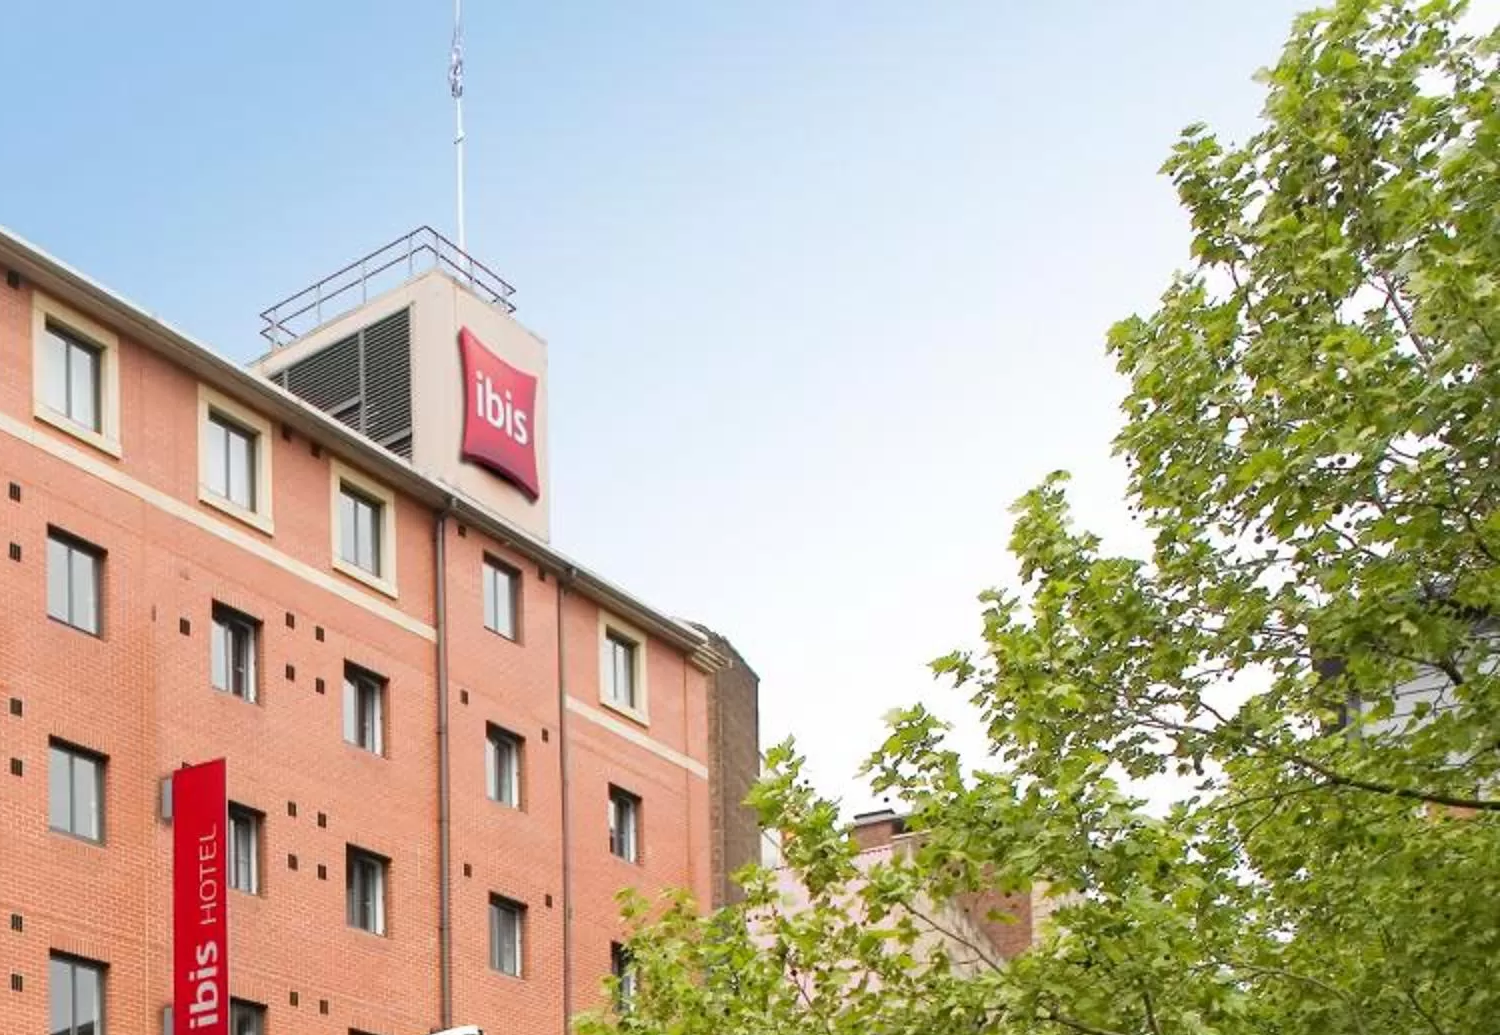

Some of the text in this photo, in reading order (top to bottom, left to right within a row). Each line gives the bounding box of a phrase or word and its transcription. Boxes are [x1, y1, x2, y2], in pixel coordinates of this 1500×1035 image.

[475, 369, 528, 445] ibis
[189, 823, 219, 1030] ibis HOTEL
